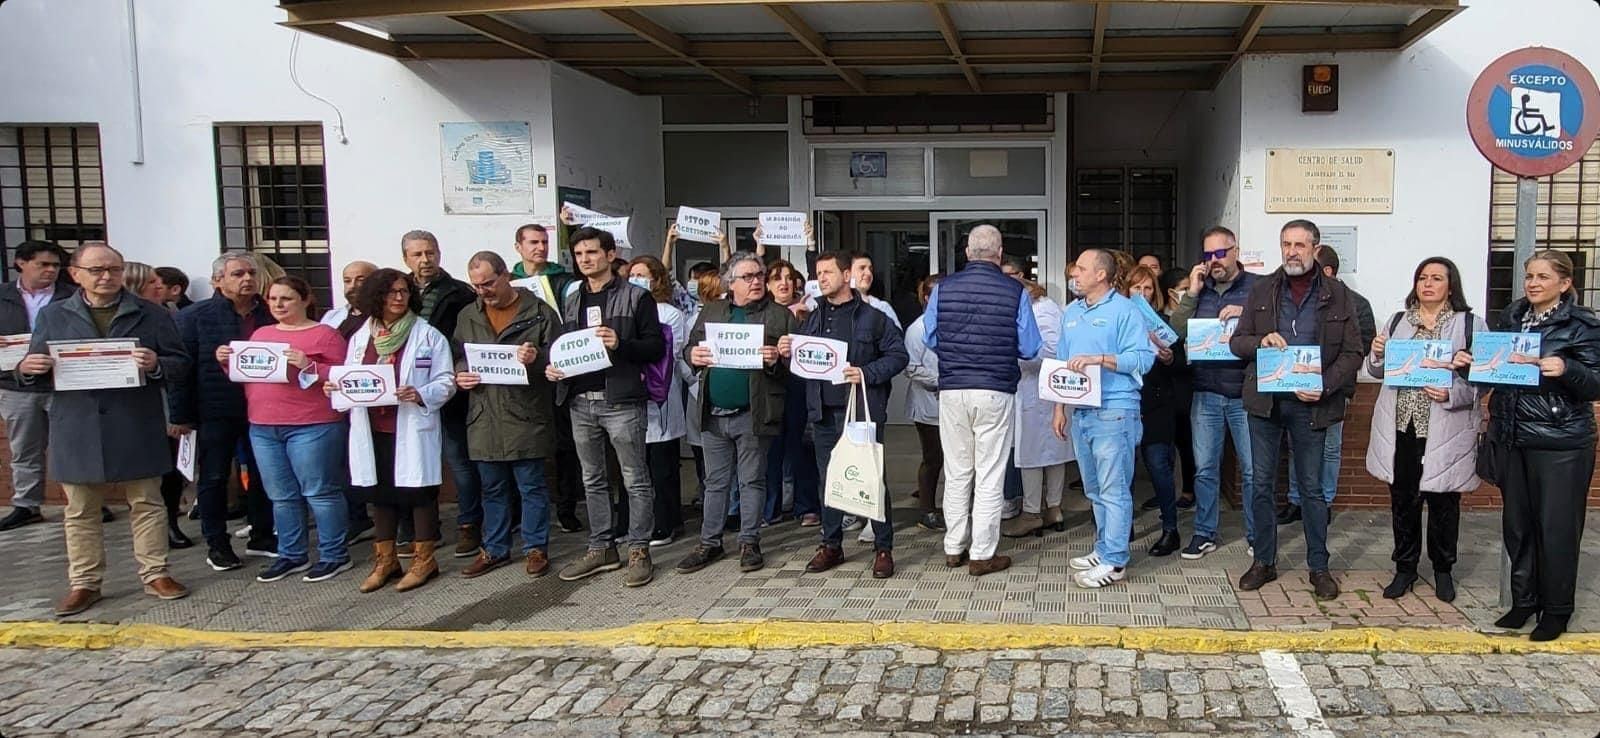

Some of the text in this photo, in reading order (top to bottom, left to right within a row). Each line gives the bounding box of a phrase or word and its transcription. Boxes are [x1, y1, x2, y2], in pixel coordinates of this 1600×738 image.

[1510, 75, 1566, 85] EXCEPTO
[1495, 137, 1573, 150] MINUSVÁLIDOS
[1298, 156, 1363, 165] CENTRO DE SALUD
[718, 331, 750, 340] #STOP
[560, 337, 590, 351] #STOP
[480, 352, 514, 361] #STOP
[553, 350, 606, 369] AGRESIONES
[798, 349, 834, 361] STOP
[240, 355, 276, 366] STOP
[799, 358, 834, 367] AGRESIONES
[342, 379, 381, 389] STOP
[1052, 374, 1088, 386] STOP
[1053, 384, 1088, 392] AGRESIONES
